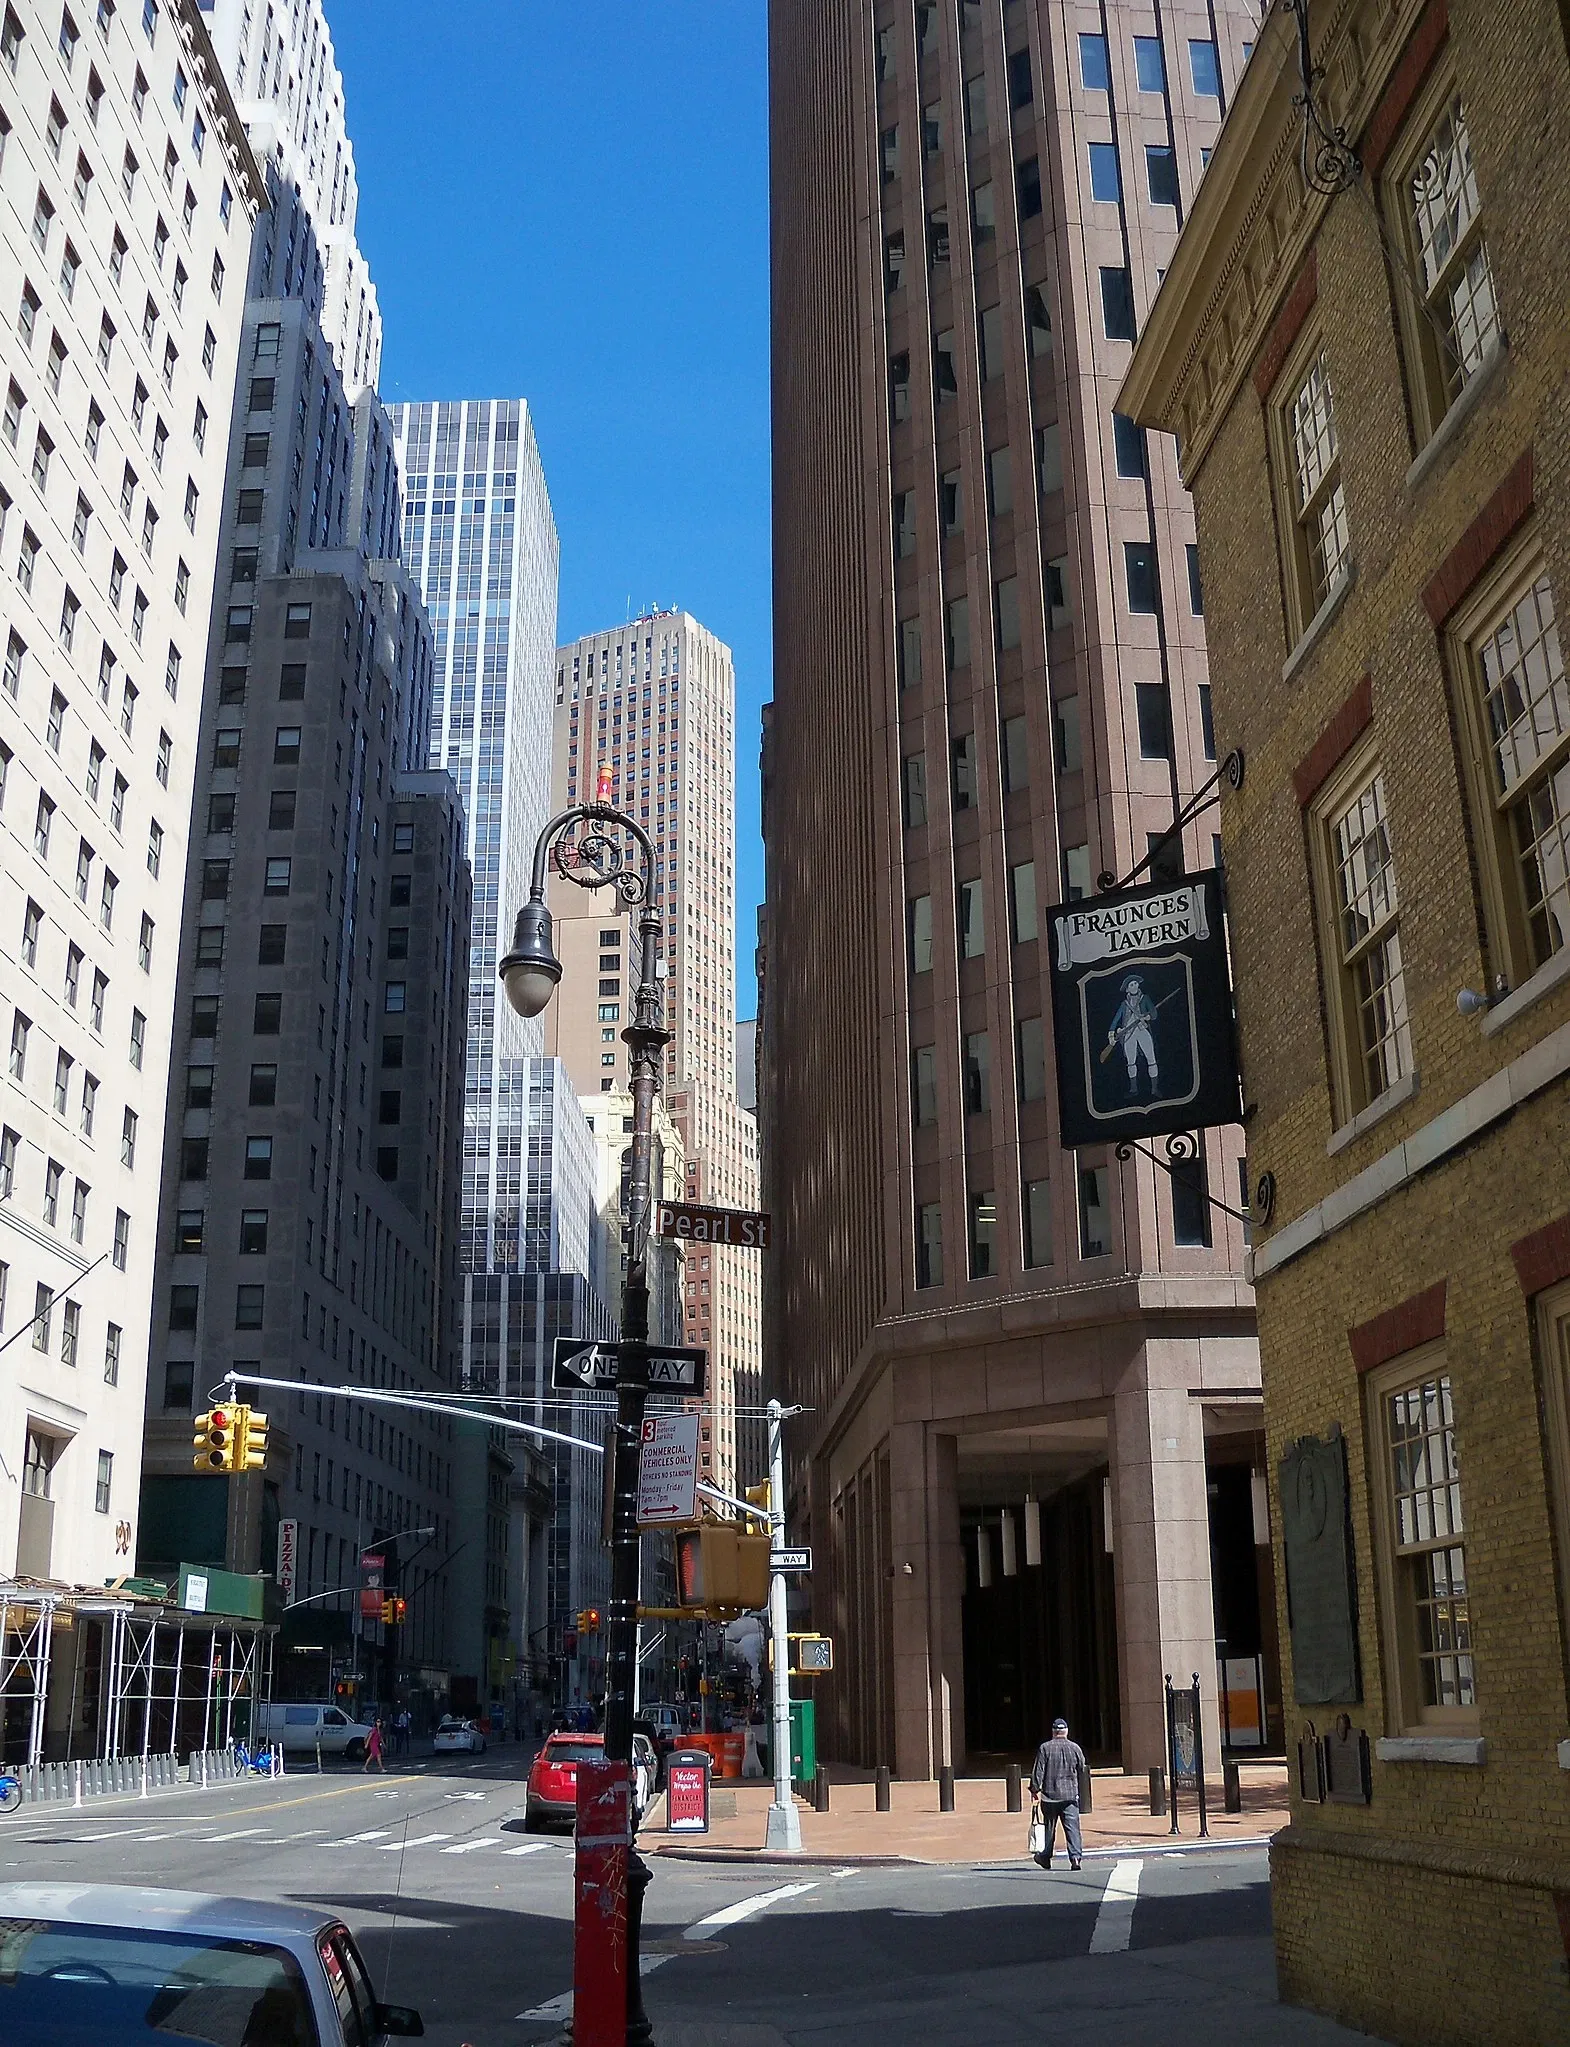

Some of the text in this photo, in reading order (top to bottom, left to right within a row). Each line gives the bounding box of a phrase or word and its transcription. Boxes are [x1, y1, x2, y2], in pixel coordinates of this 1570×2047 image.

[1071, 894, 1190, 937] FRAUNCES
[1104, 918, 1191, 953] TAVERN
[659, 1208, 767, 1247] Pearl St
[578, 1355, 618, 1377] ONE
[644, 1421, 655, 1441] 3
[656, 1425, 676, 1434] metered
[656, 1433, 674, 1441] parking
[644, 1445, 686, 1457] COMMERCIAL
[643, 1454, 693, 1468] VEHICLES ONLY
[642, 1469, 692, 1480] OTHERS NO STANDING
[641, 1485, 662, 1494] Monday
[666, 1483, 684, 1492] Friday
[280, 1523, 295, 1572] PIZZA
[783, 1555, 802, 1564] WAY
[675, 1771, 699, 1781] Vector
[673, 1781, 702, 1792] Wraps the
[674, 1803, 700, 1811] DISTRICT
